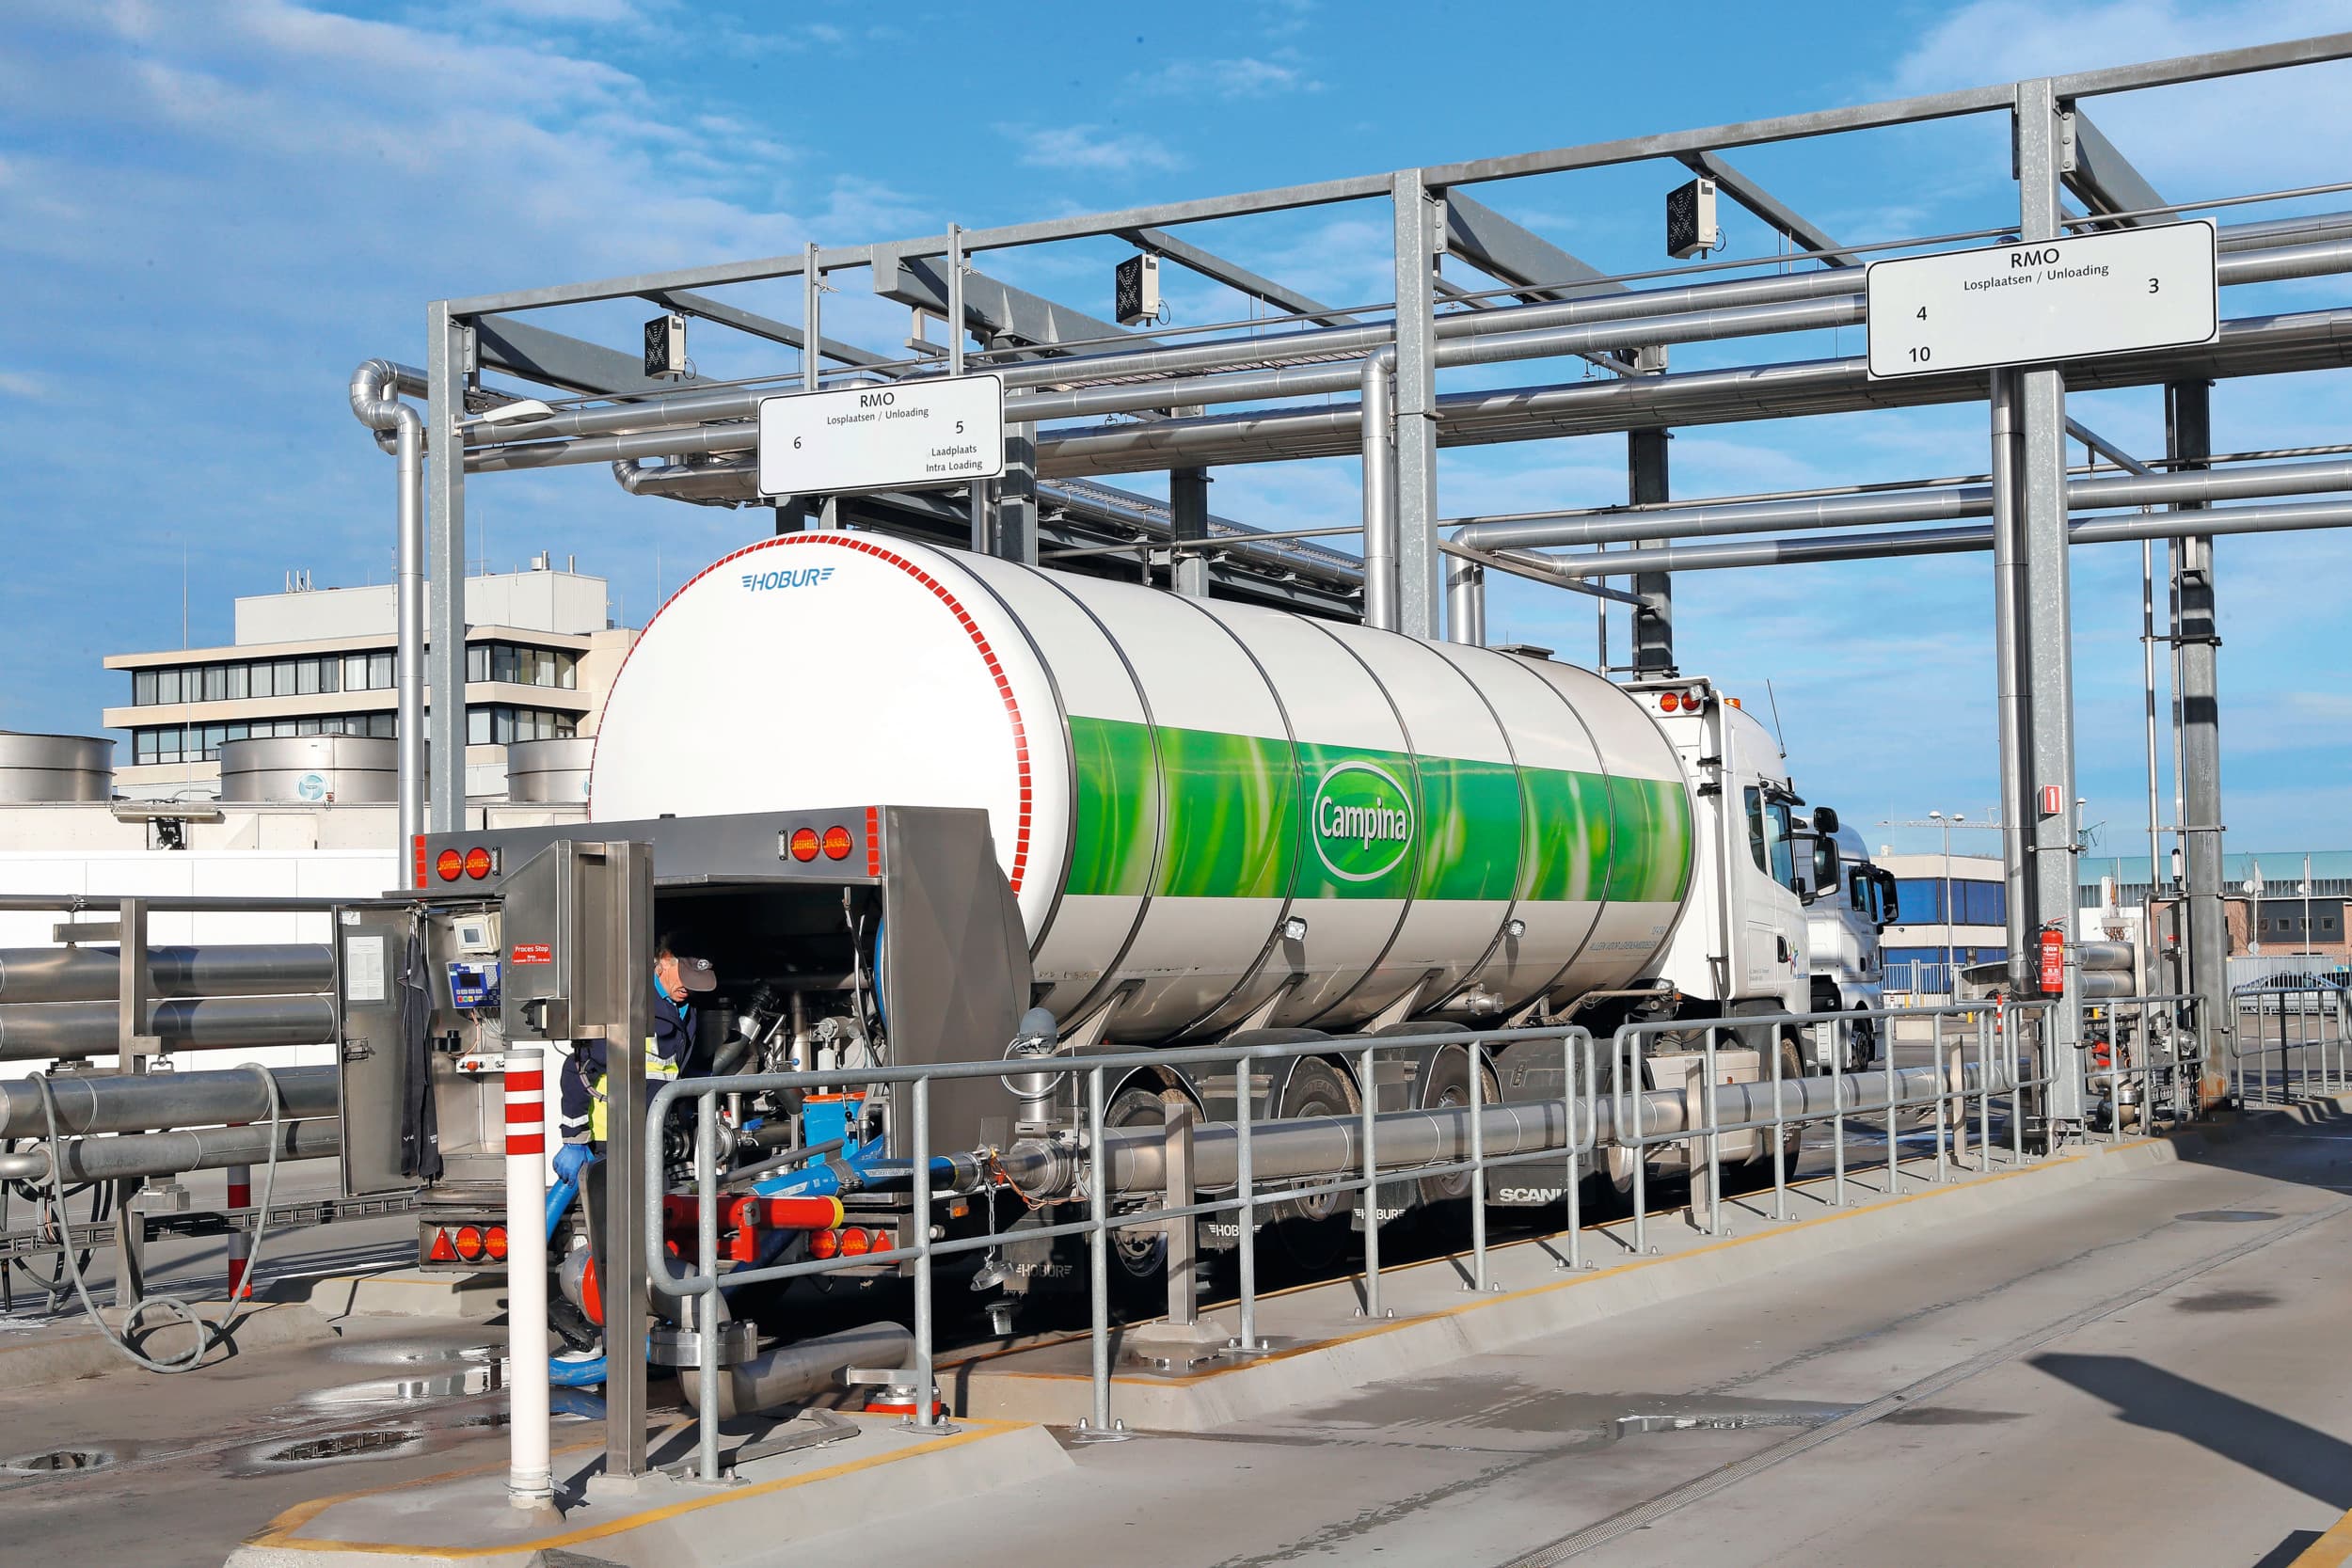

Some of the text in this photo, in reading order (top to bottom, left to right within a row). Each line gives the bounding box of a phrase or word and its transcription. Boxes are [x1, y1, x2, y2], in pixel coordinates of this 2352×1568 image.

[2010, 247, 2059, 269] RMO
[1963, 263, 2109, 292] Losplaatsen / Unloading
[2148, 277, 2160, 293] 3
[1915, 306, 1928, 322] 4
[1908, 346, 1931, 363] 10
[860, 392, 895, 408] RMO
[827, 412, 875, 425] Losplaatsen
[885, 407, 930, 420] Unloading
[955, 420, 964, 435] 5
[793, 436, 802, 450] 6
[931, 444, 977, 457] Laadplaats
[926, 459, 983, 473] Intra Loading
[752, 568, 820, 592] HOBUR
[1319, 796, 1406, 850] Campina
[1499, 1188, 1568, 1202] SCANI
[1216, 1224, 1255, 1237] HOB
[1022, 1263, 1065, 1278] HOBUR
